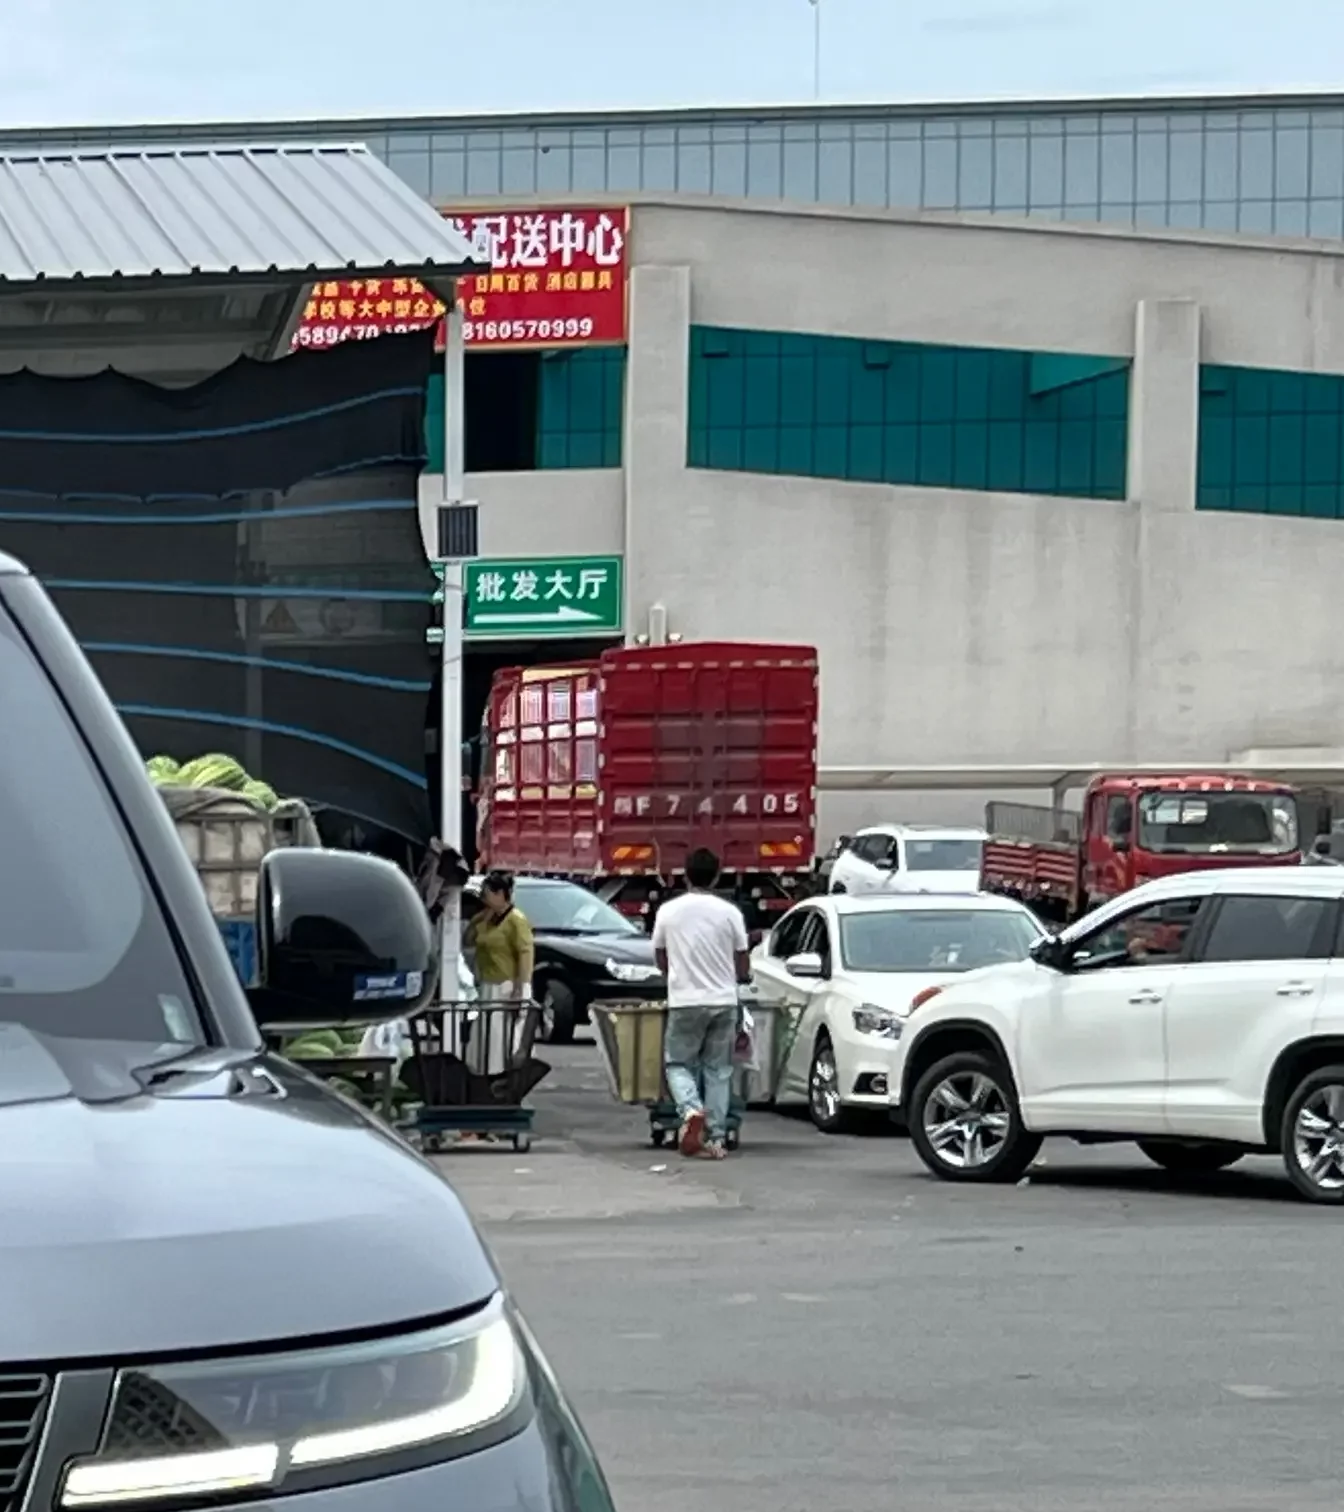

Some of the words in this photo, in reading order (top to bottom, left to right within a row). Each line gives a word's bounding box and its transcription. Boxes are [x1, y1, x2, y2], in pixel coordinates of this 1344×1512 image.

[448, 213, 625, 268] 配送中心
[476, 569, 608, 602] 批发大厅
